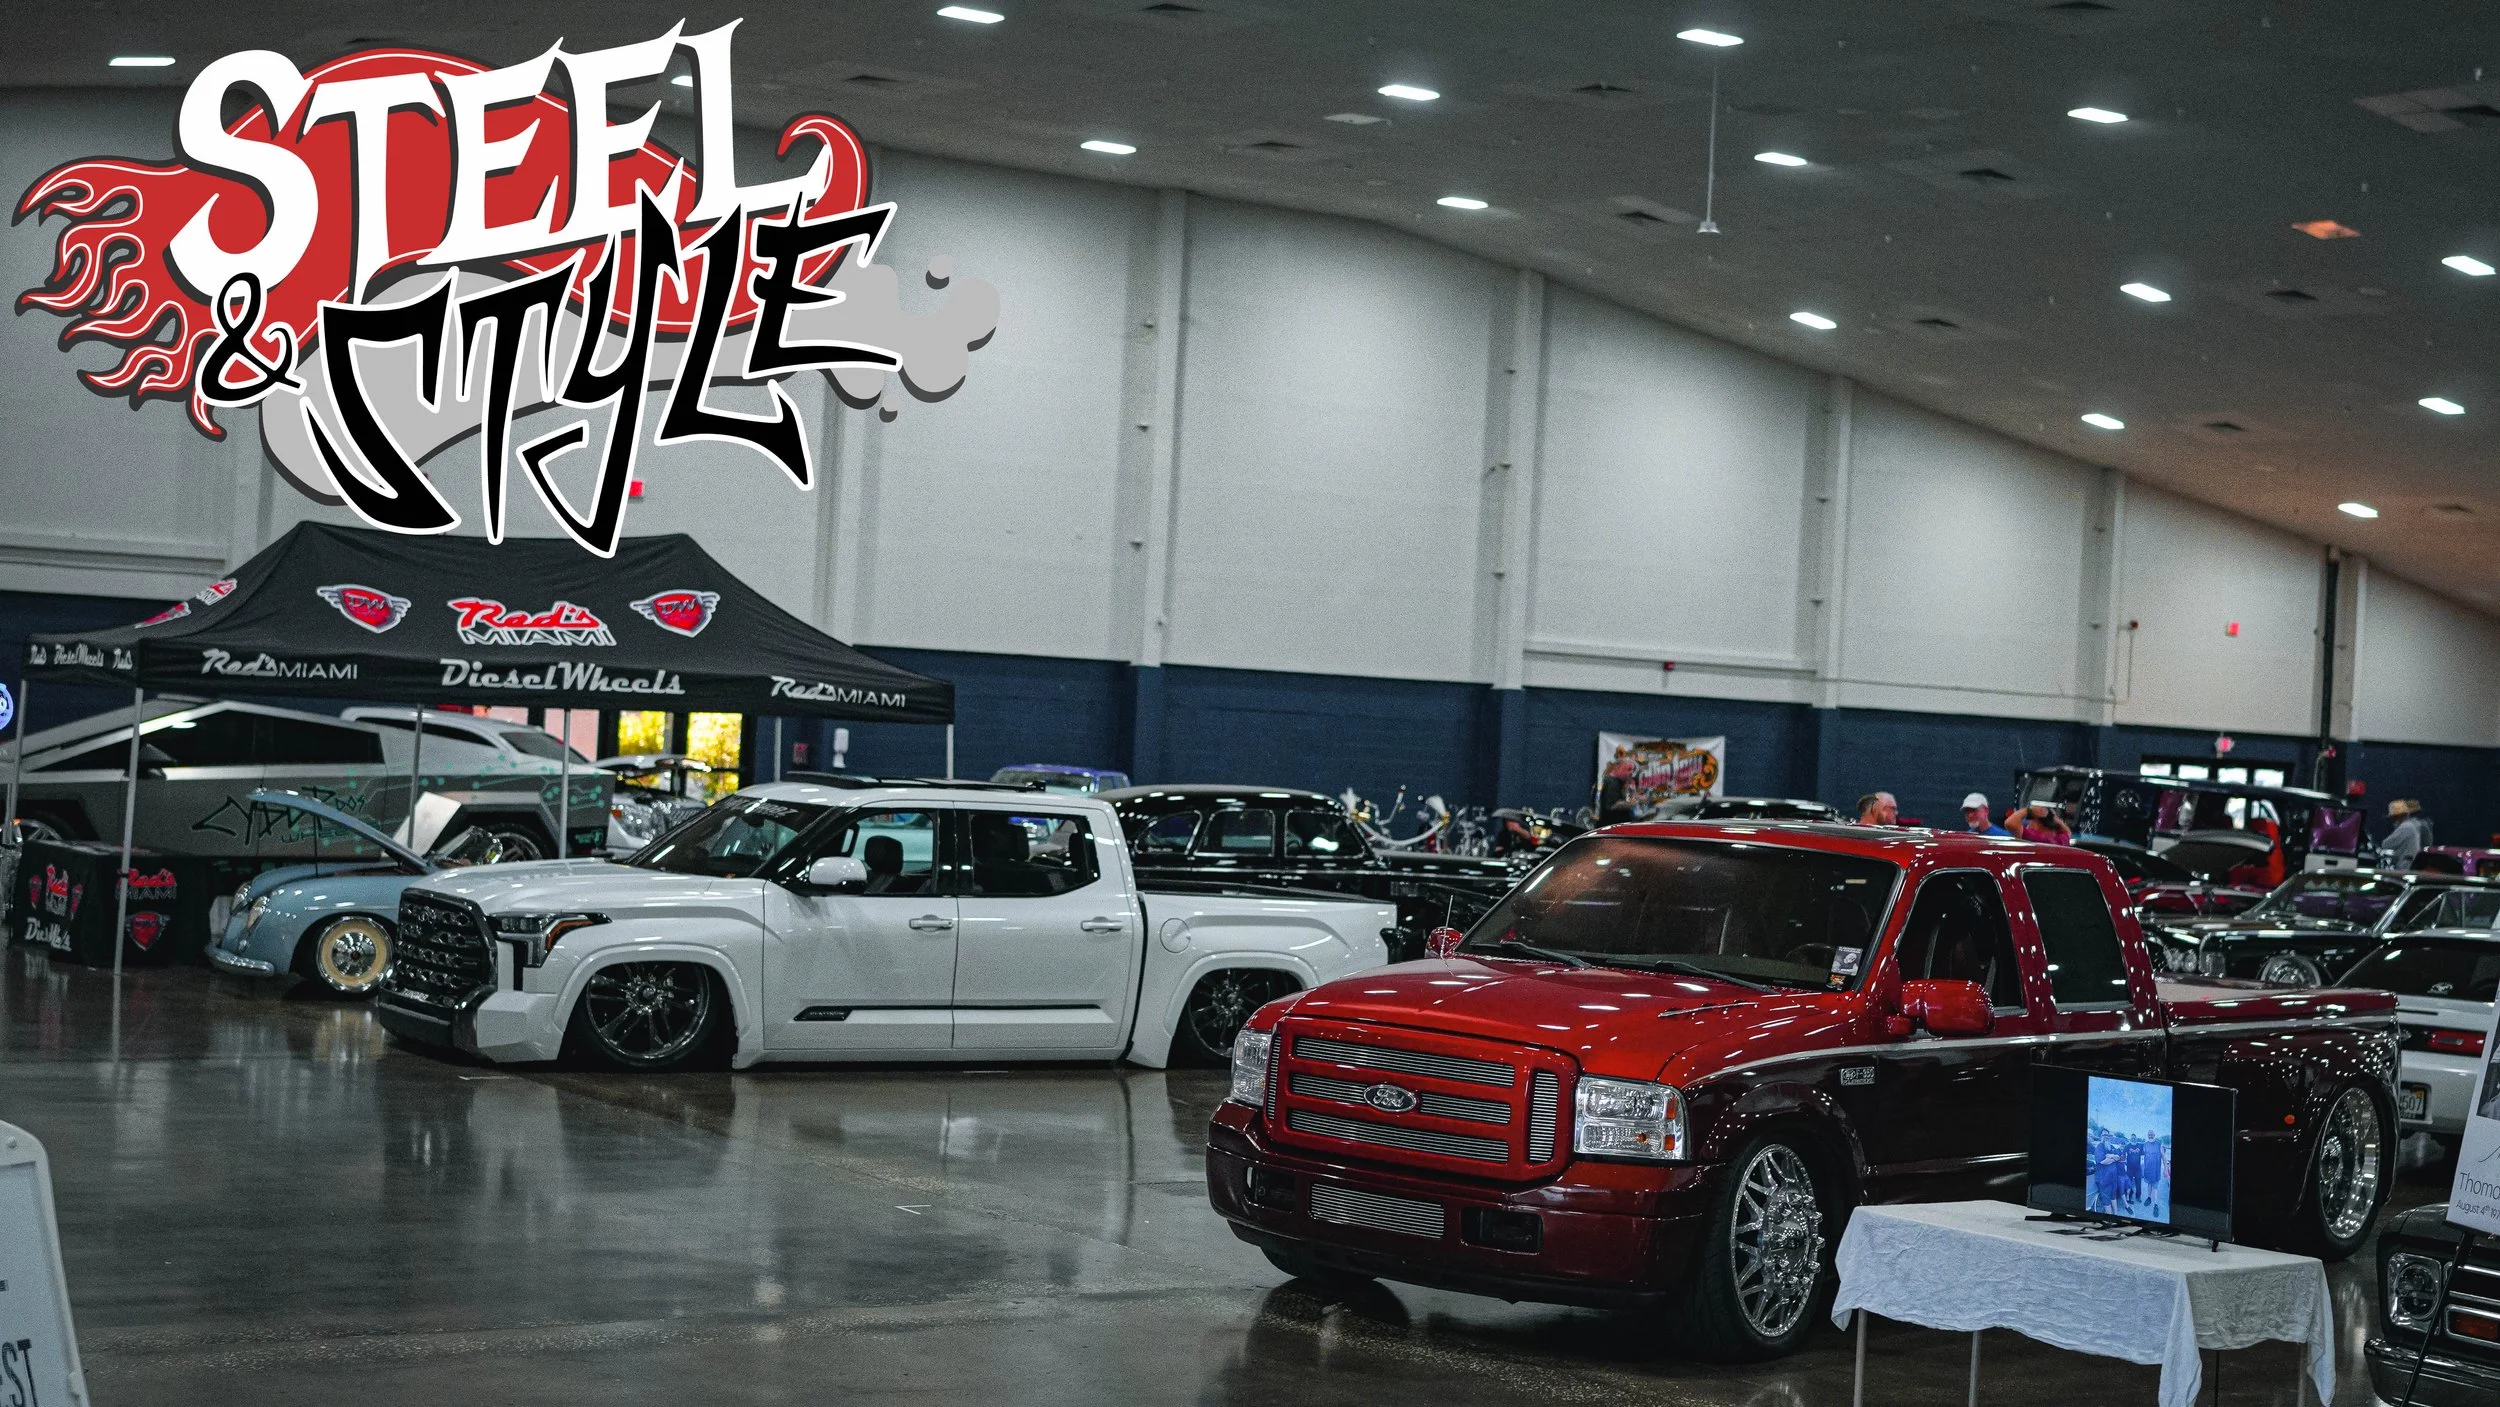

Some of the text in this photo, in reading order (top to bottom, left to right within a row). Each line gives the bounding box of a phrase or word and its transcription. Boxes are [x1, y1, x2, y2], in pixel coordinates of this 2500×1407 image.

[448, 598, 602, 629] Red's
[459, 627, 617, 646] MIAMI
[278, 662, 358, 679] MIAMI
[837, 688, 906, 707] MIAMI
[1373, 1089, 1405, 1108] Ford
[2455, 1200, 2480, 1214] August
[0, 1339, 39, 1407] ST
